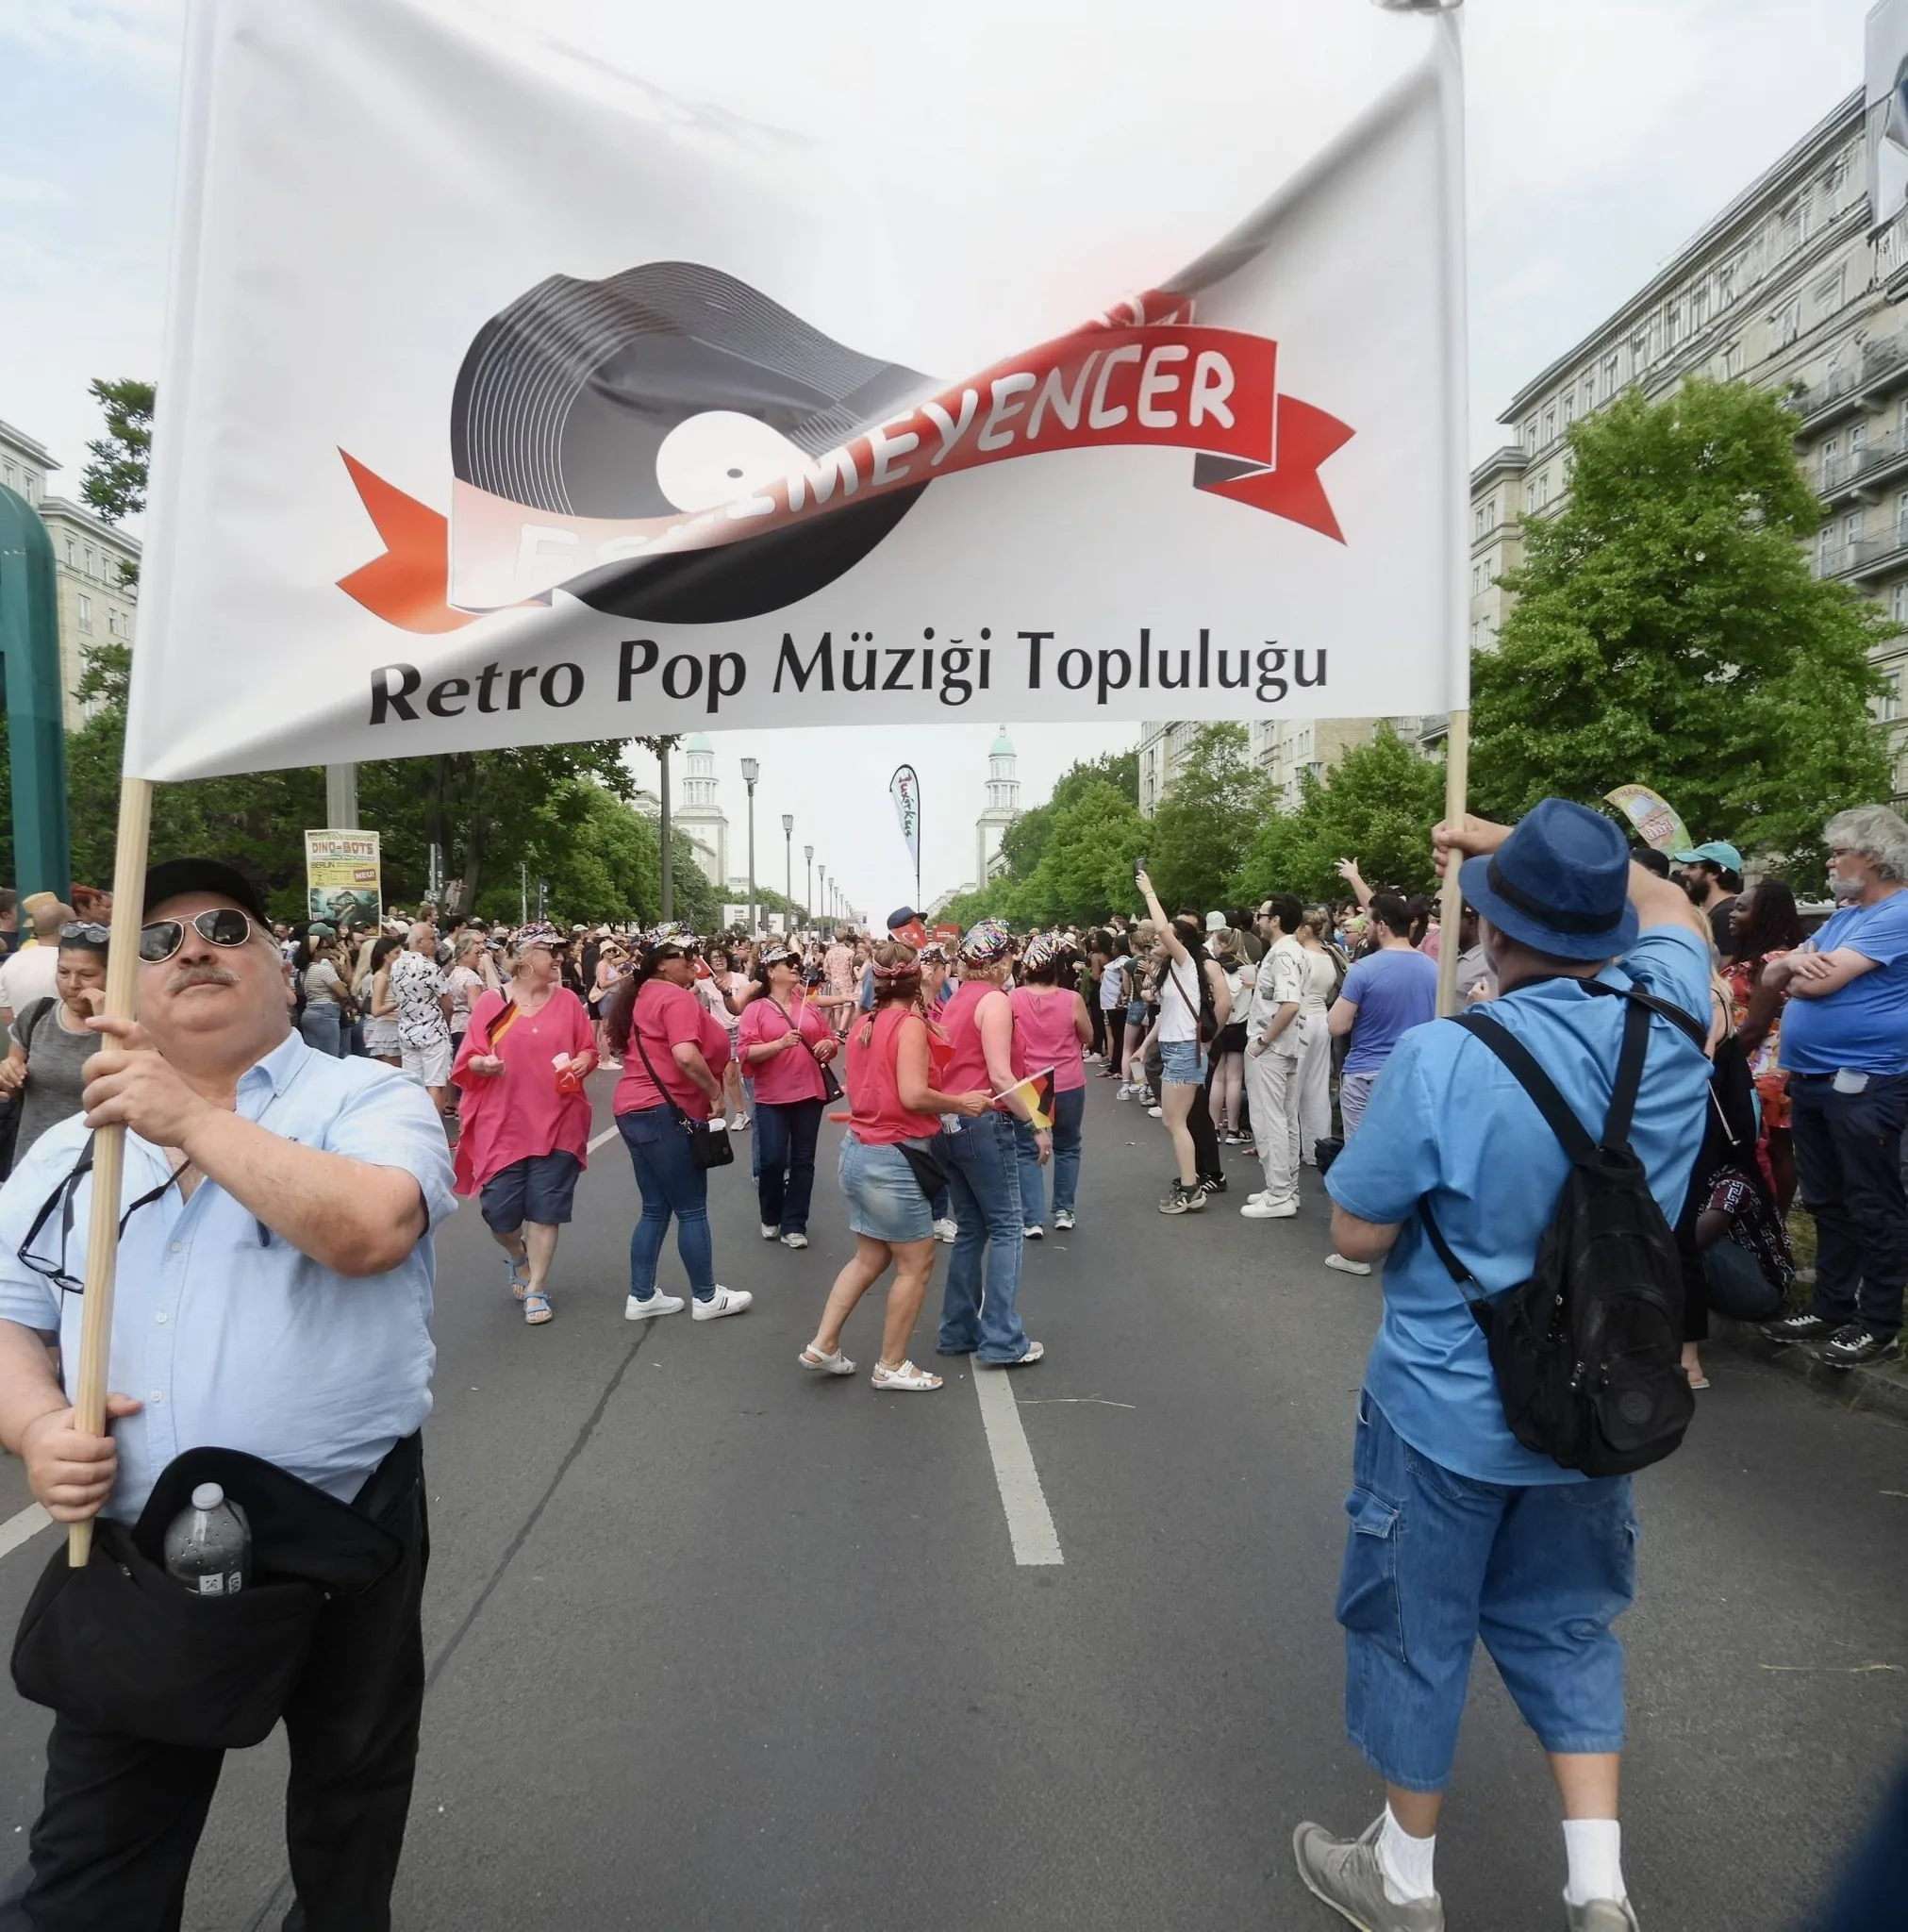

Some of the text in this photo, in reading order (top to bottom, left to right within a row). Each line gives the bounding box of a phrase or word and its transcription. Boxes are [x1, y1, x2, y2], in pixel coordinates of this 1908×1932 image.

[368, 626, 1328, 726] Retro Pop Müziği Topluluğu
[312, 841, 373, 855] DINO-BOTS
[355, 871, 375, 880] NEU!
